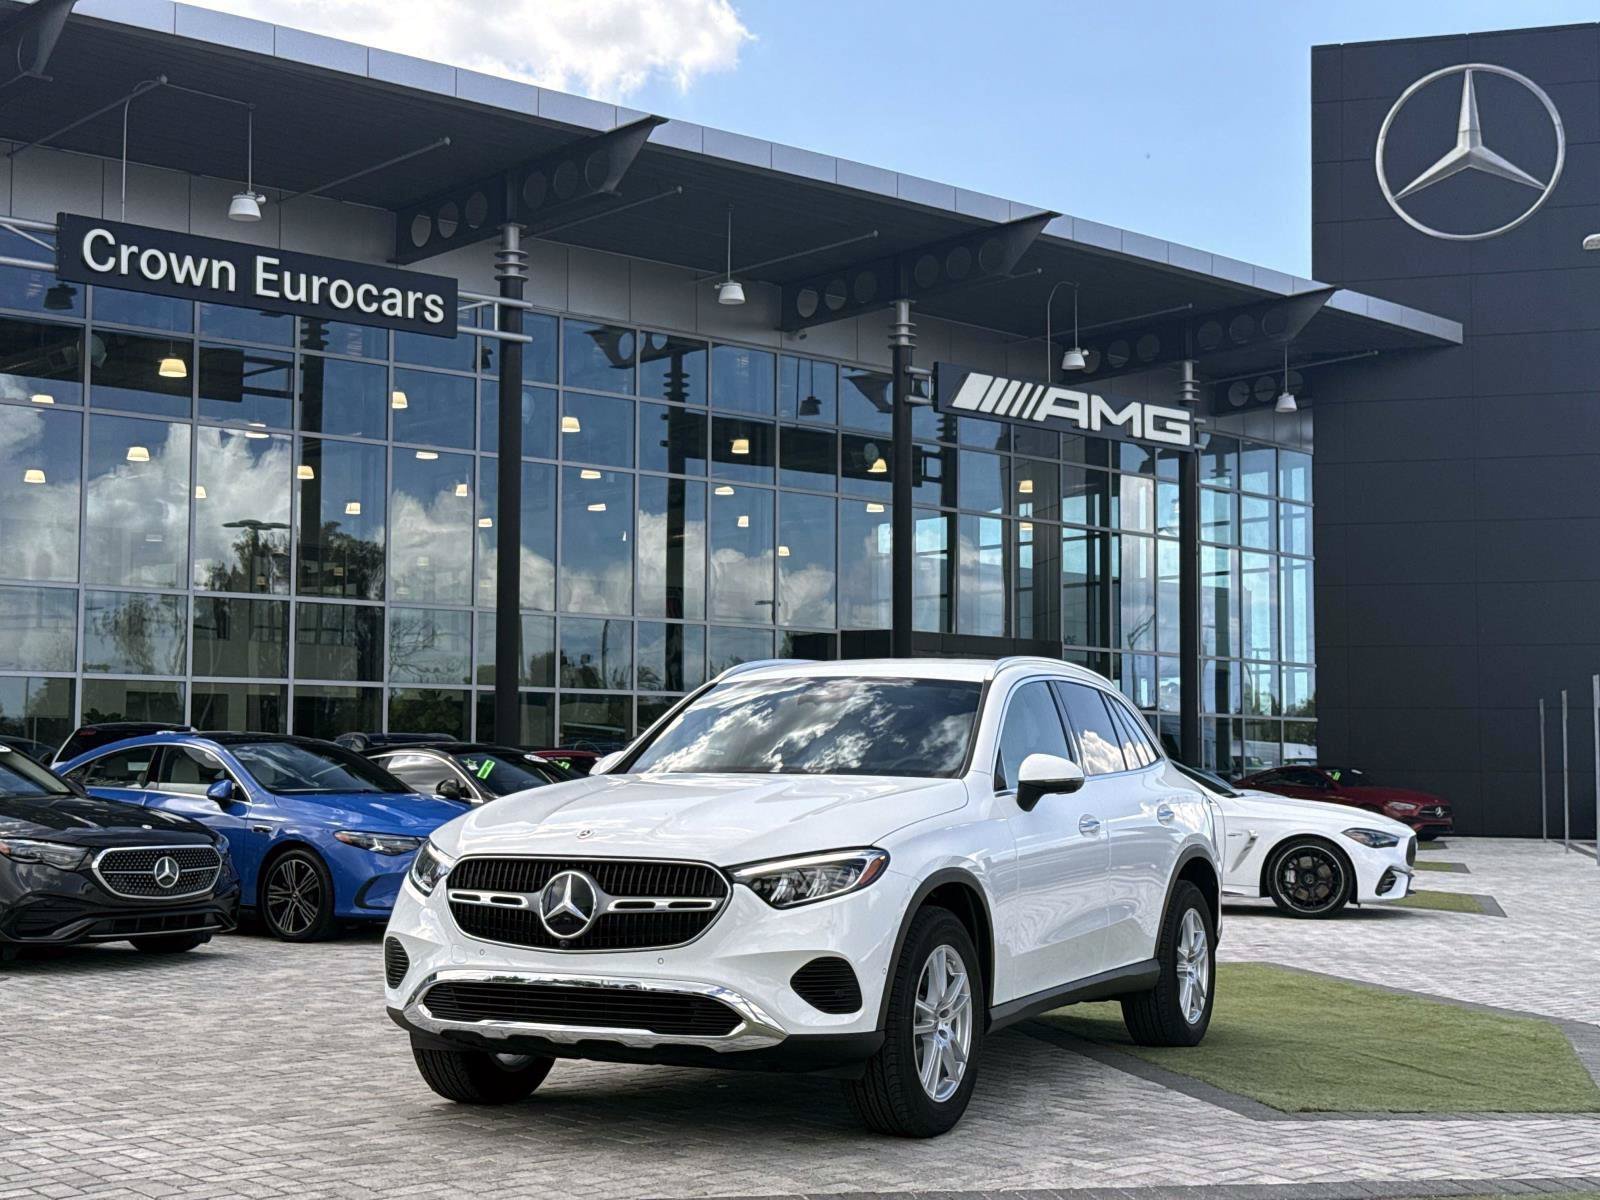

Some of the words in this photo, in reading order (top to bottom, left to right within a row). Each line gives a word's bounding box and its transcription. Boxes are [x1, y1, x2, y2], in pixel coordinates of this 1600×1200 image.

[81, 228, 236, 292] Crown
[255, 255, 445, 324] Eurocars
[1032, 386, 1191, 446] AMG
